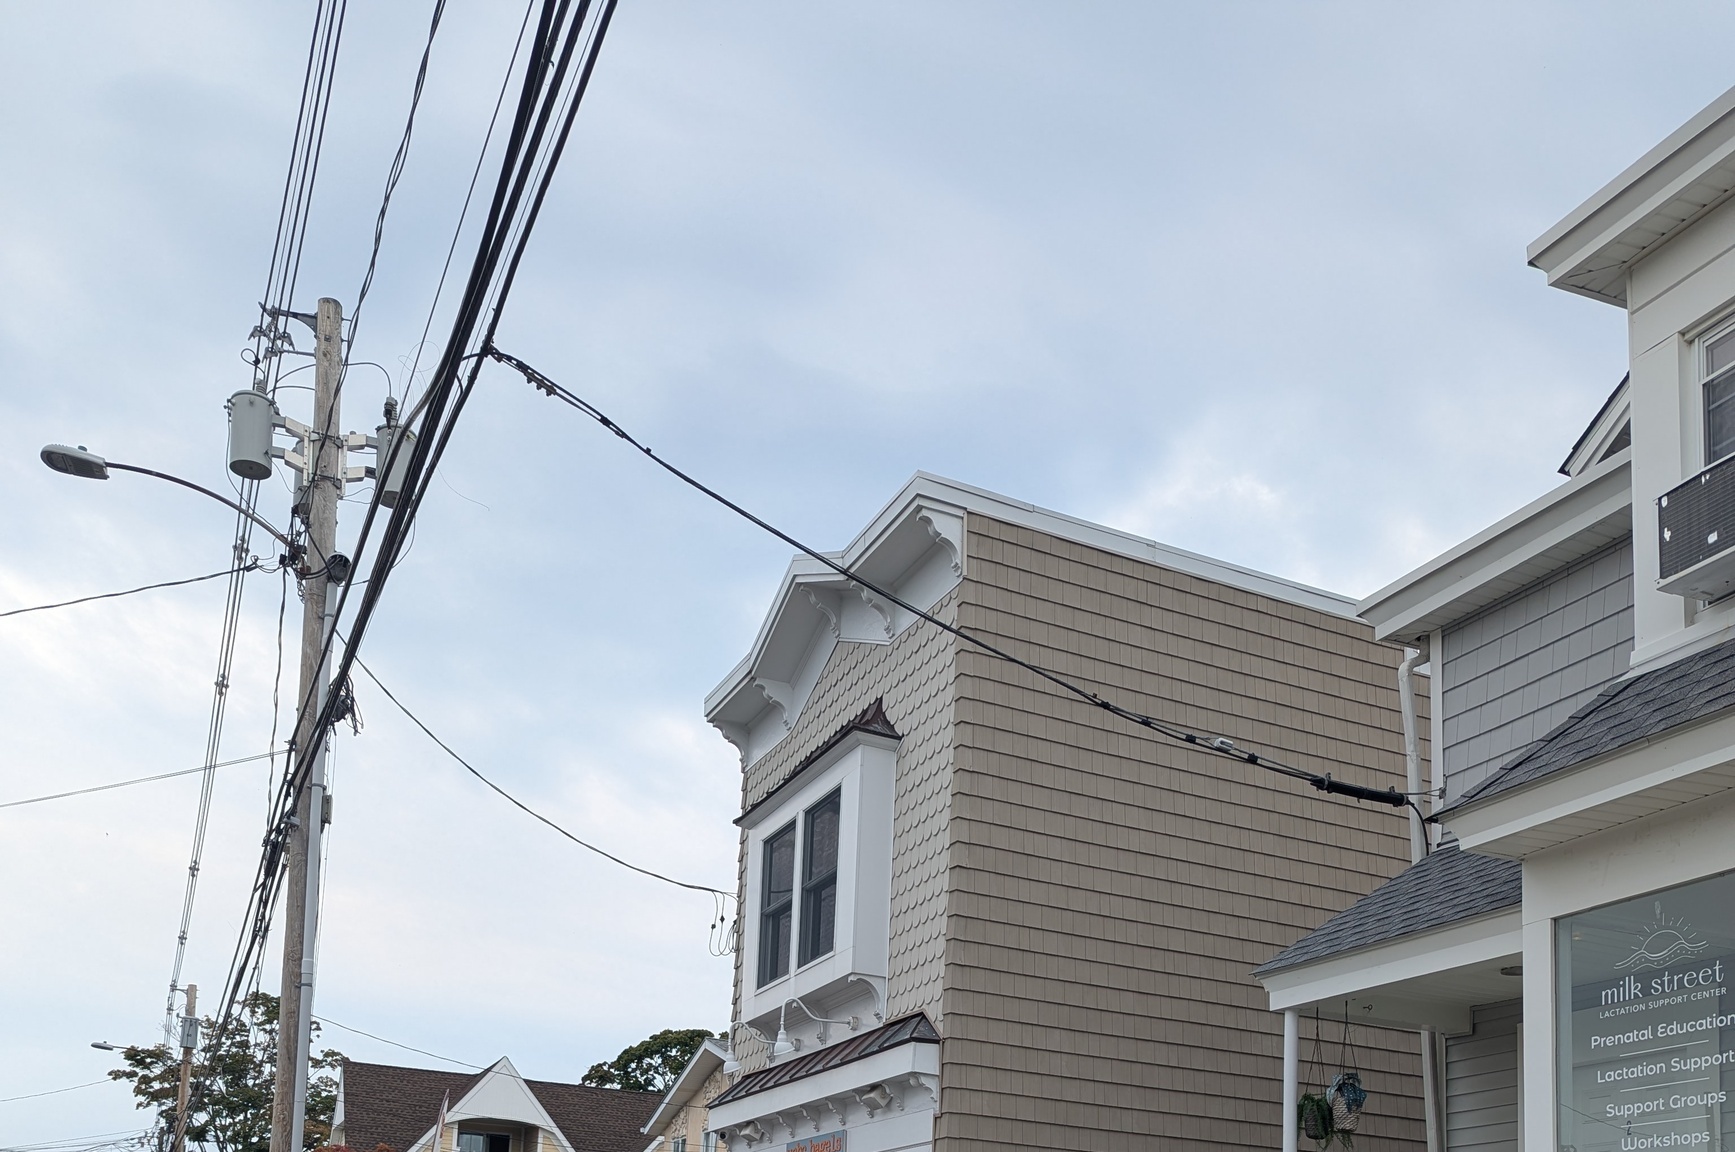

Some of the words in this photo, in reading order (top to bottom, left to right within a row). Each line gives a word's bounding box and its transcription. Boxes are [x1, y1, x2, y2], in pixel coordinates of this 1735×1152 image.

[1601, 975, 1643, 1006] milk
[1651, 960, 1725, 995] street
[1599, 1003, 1646, 1019] LACTATION
[1648, 995, 1689, 1010] SUPPORT
[1690, 986, 1727, 1000] CENTER
[1591, 1025, 1653, 1049] Prenatal
[1657, 1013, 1735, 1037] Education
[1597, 1062, 1666, 1083] Lactation
[1670, 1049, 1735, 1072] Support
[1606, 1097, 1665, 1118] Support
[1669, 1090, 1727, 1107] Groups
[1621, 1131, 1711, 1151] Workshops
